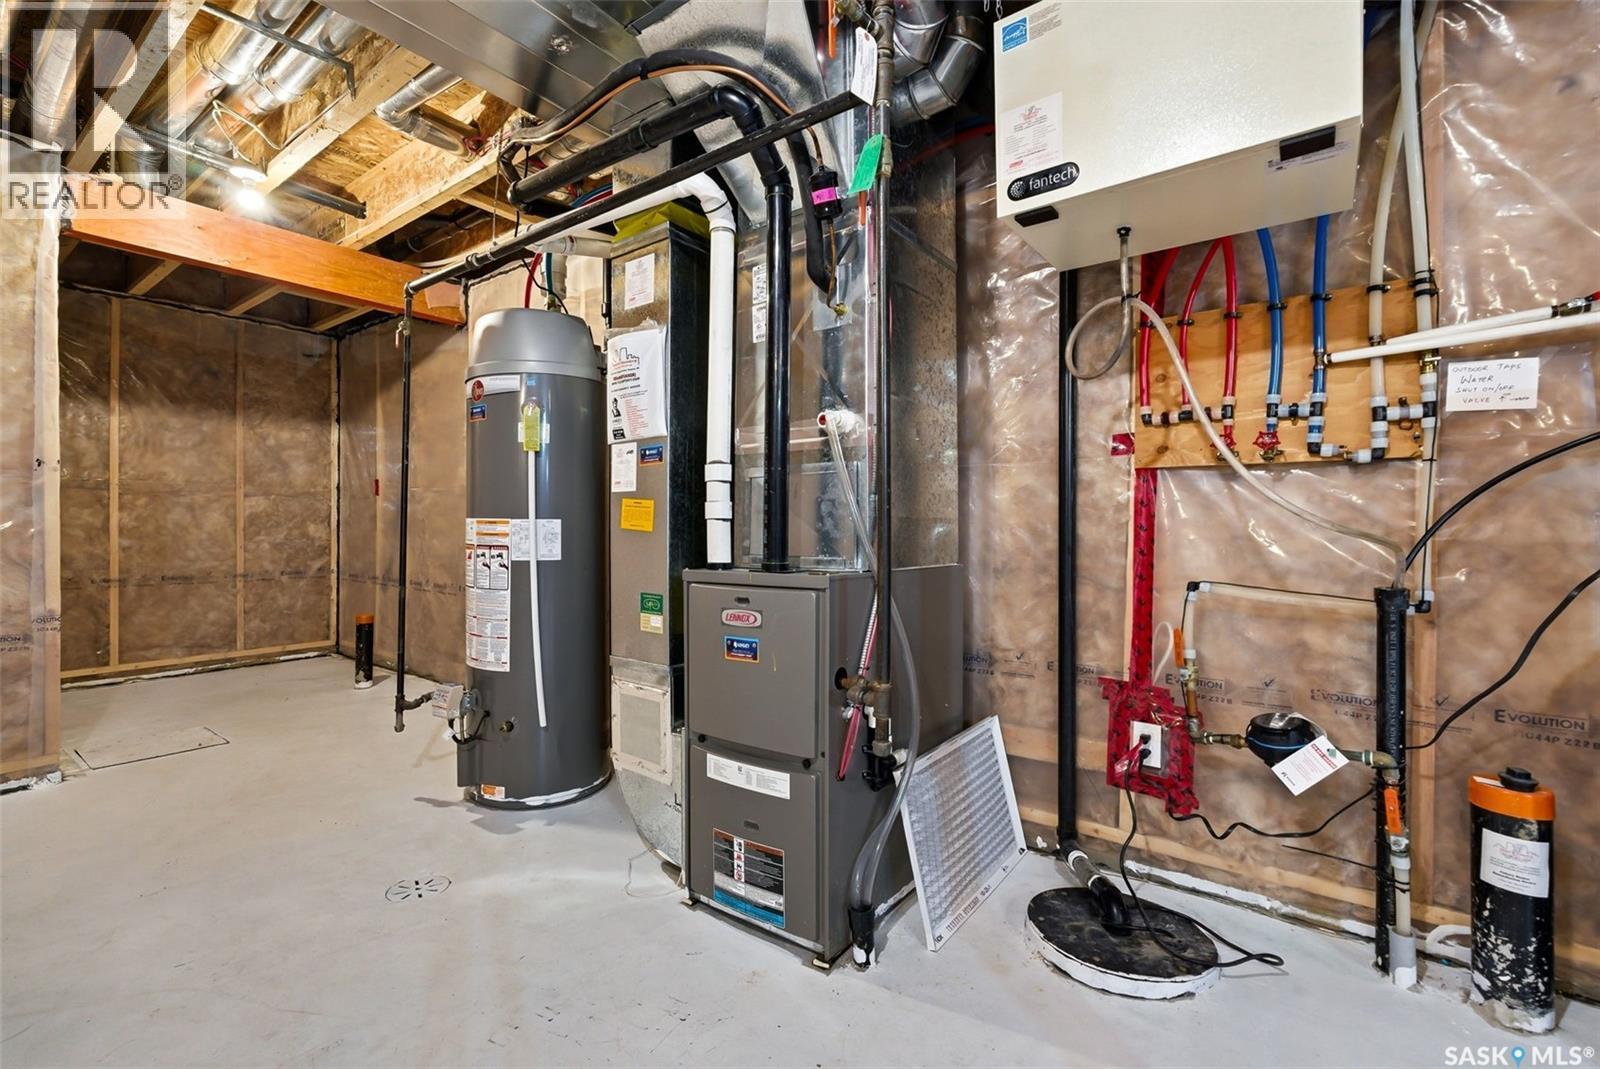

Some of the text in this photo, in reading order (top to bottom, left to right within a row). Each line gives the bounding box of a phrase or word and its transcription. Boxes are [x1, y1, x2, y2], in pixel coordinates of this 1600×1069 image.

[1029, 166, 1076, 191] fantech
[725, 612, 752, 624] LENNOX
[1494, 708, 1586, 731] EVOLUTION
